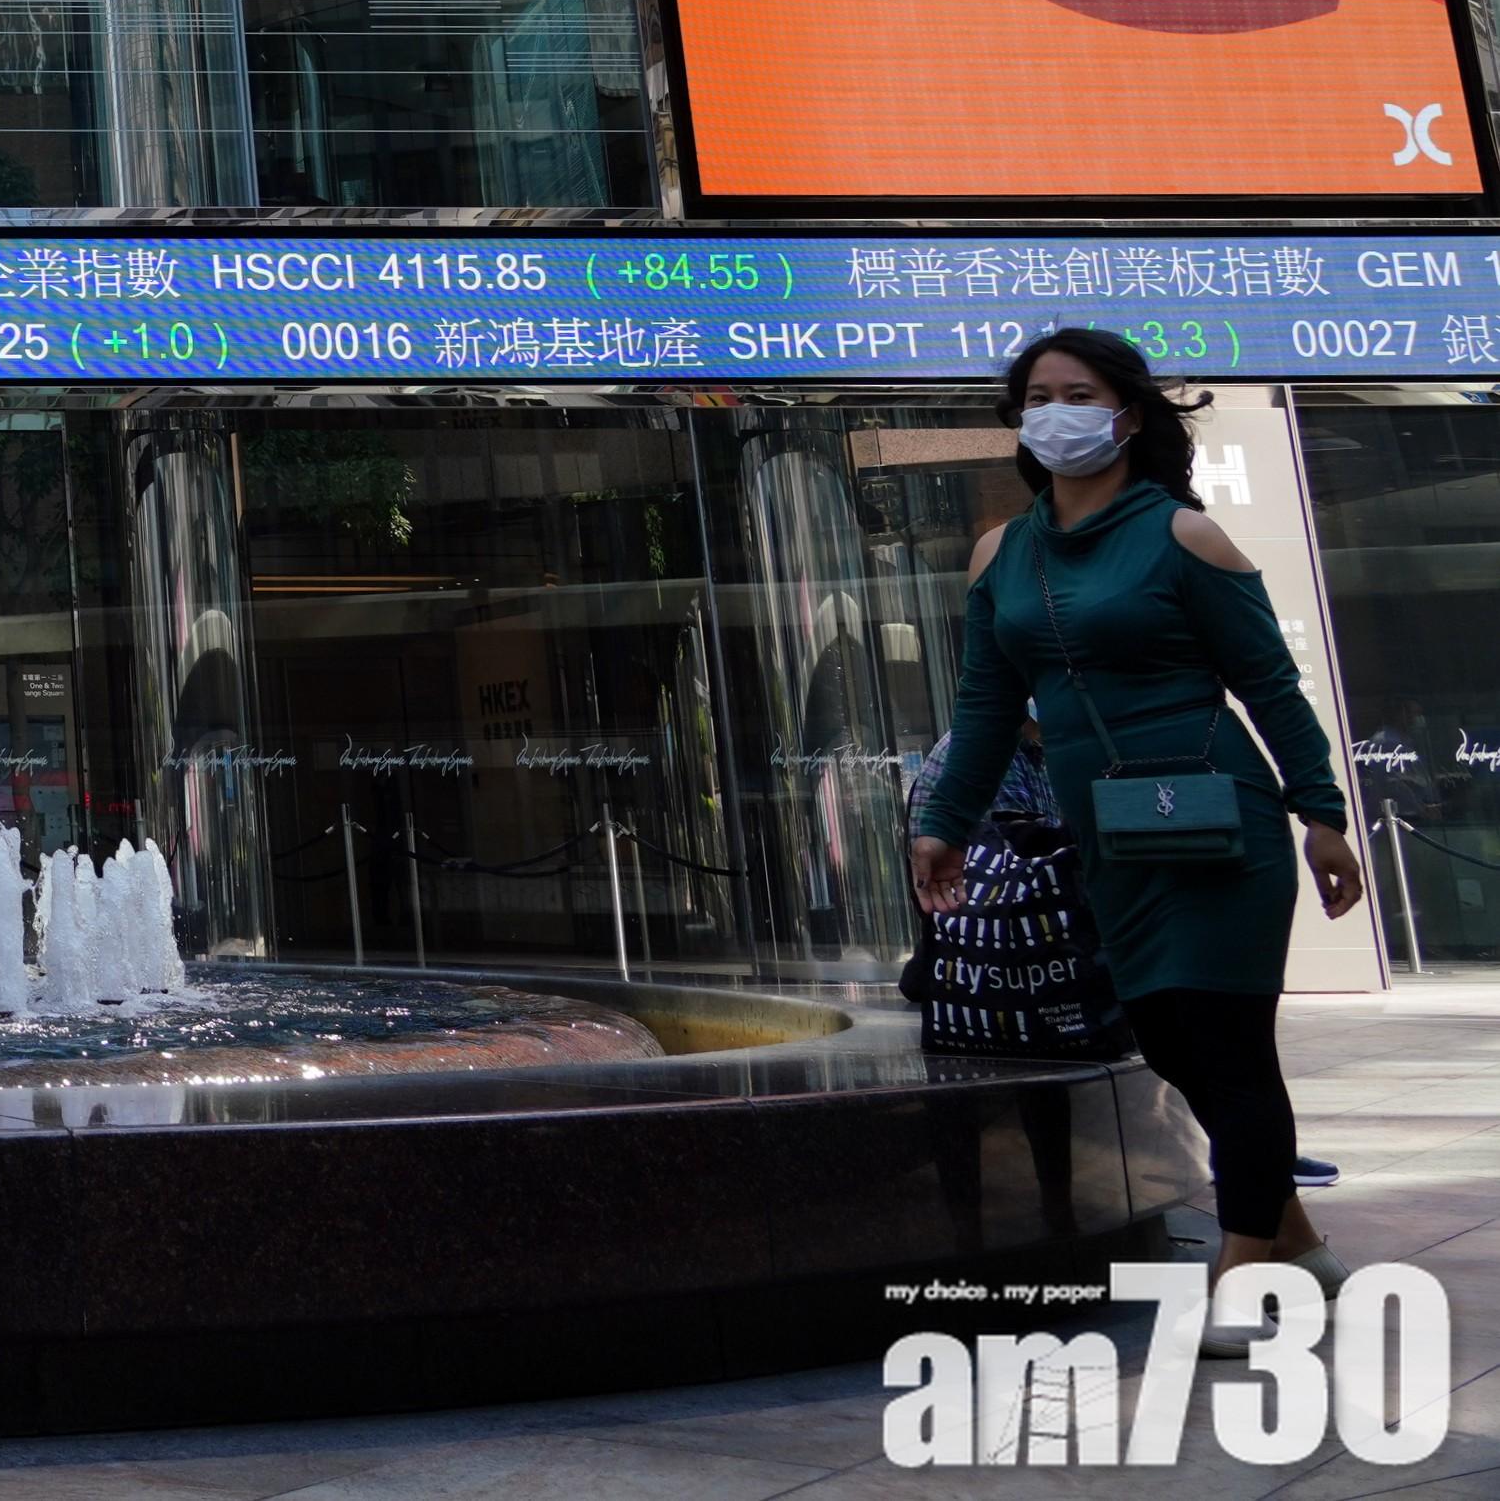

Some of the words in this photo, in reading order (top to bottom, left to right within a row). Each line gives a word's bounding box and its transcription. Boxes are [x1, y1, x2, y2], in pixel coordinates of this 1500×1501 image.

[212, 253, 357, 292] HSCCI
[378, 253, 548, 292] 4115.85
[848, 245, 1333, 299] 標普香港創業板指數
[1357, 251, 1463, 289] GEM
[282, 323, 414, 361] 00016
[434, 317, 706, 370] 新鴻基地產
[728, 323, 823, 361] SHK
[837, 323, 925, 361] PPT
[1292, 320, 1418, 359] 00027
[1441, 314, 1500, 365] 銀
[1044, 1012, 1084, 1026] Shanghai
[1056, 1022, 1086, 1034] Taiwan
